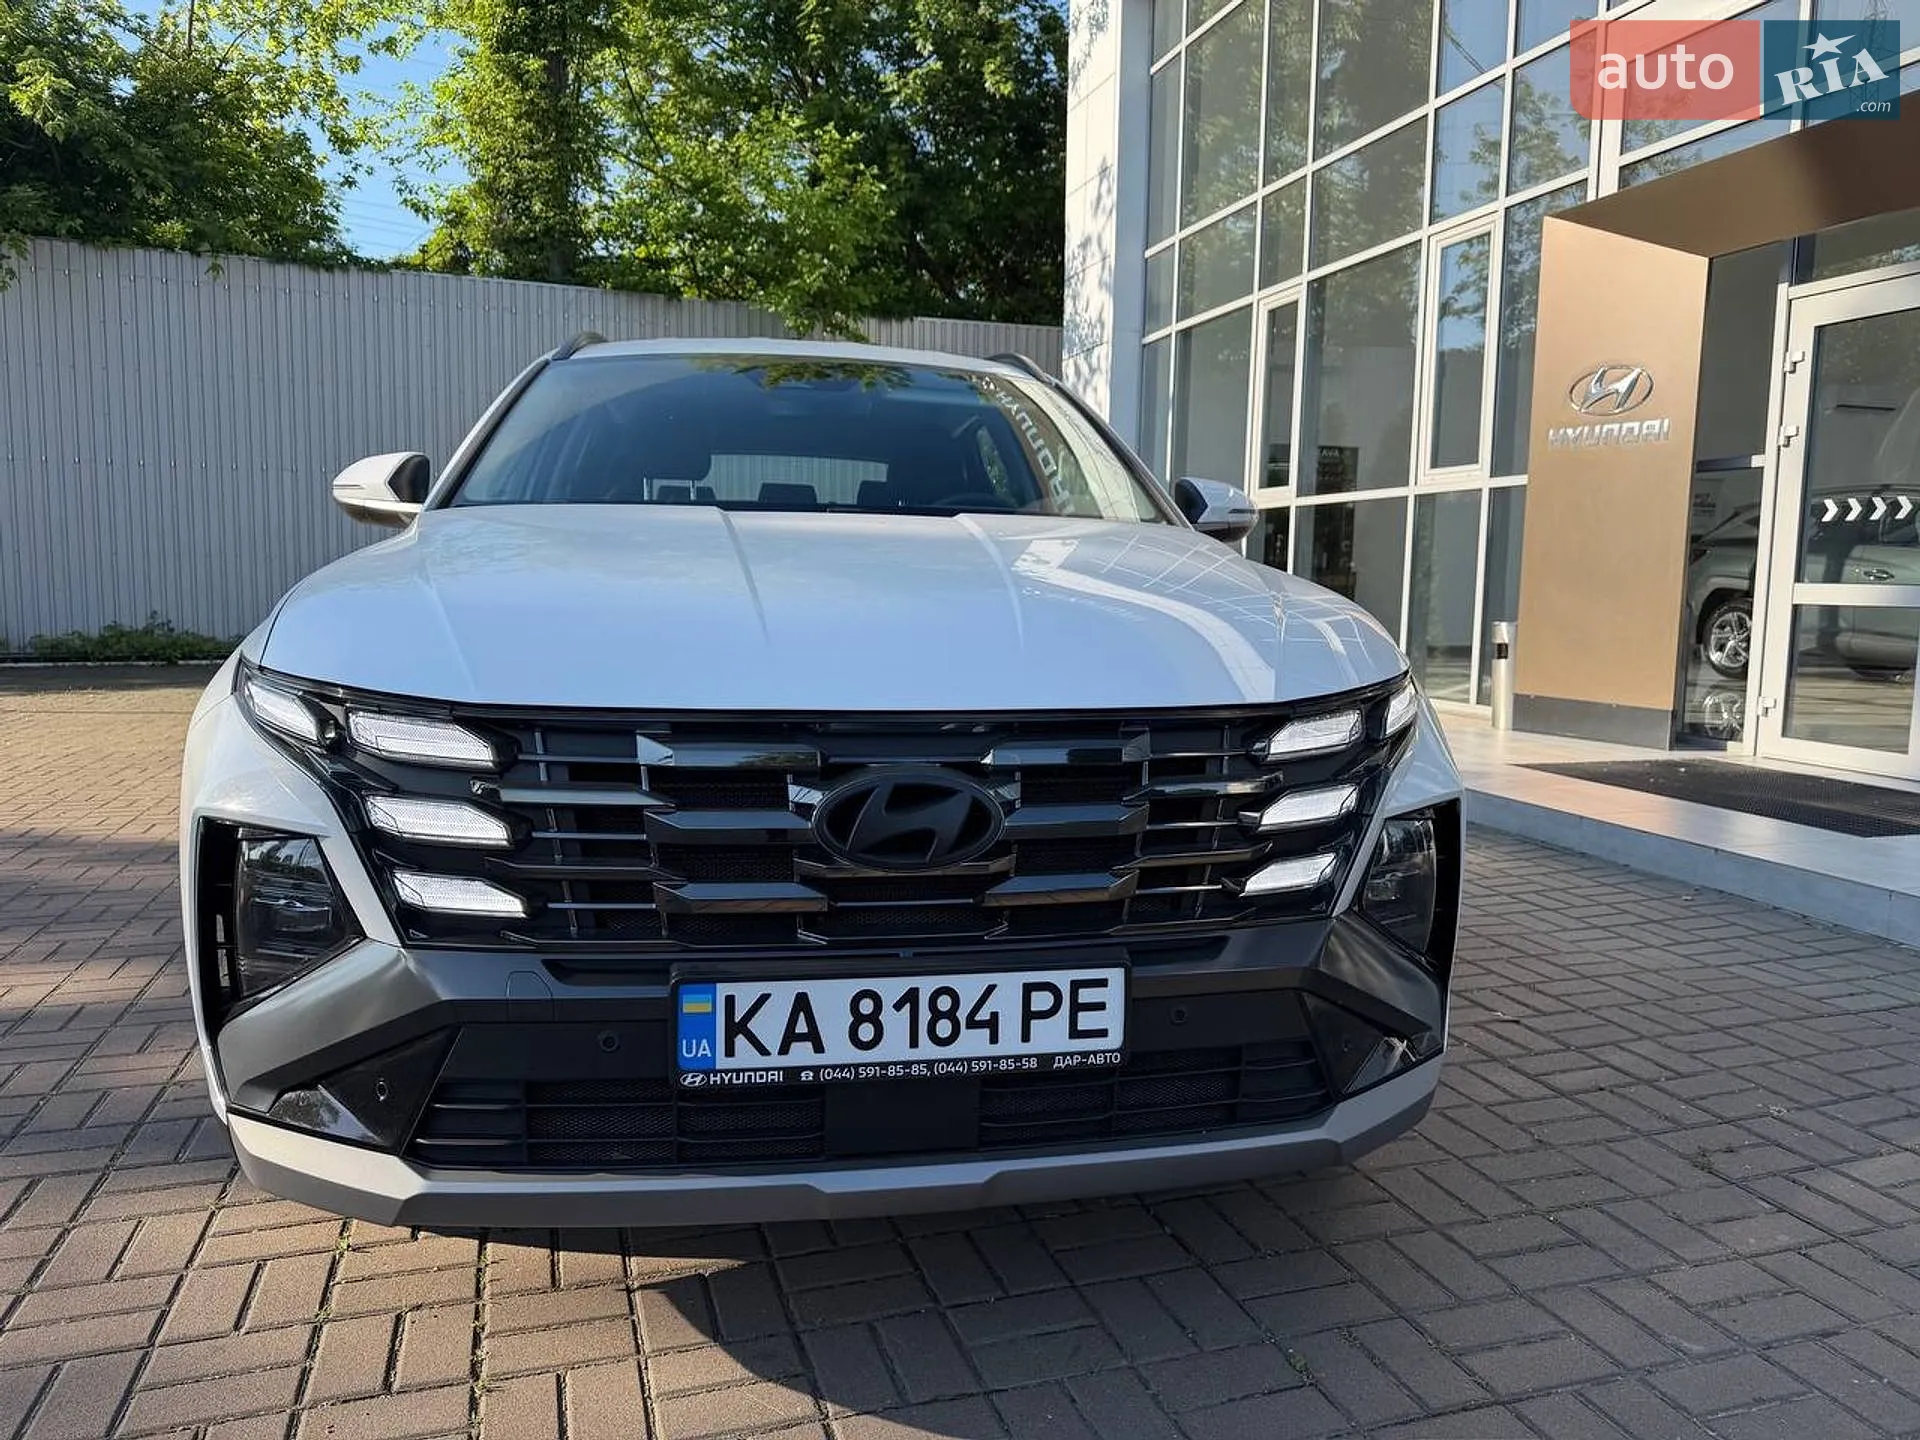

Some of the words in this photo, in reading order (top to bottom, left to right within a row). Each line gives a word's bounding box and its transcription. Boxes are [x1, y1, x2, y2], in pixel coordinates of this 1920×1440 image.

[1548, 418, 1670, 446] HYUNDAI
[724, 993, 825, 1058] KA
[847, 984, 999, 1051] 8184
[1021, 978, 1109, 1043] PE
[682, 1039, 711, 1058] UA
[820, 1066, 855, 1081] (044)
[858, 1063, 931, 1078] 591-85-85,
[934, 1061, 968, 1075] (044)
[971, 1058, 1038, 1072] 591-85-58
[1053, 1052, 1121, 1070] ДАР-АВТО
[710, 1070, 783, 1085] HYUNDAI
